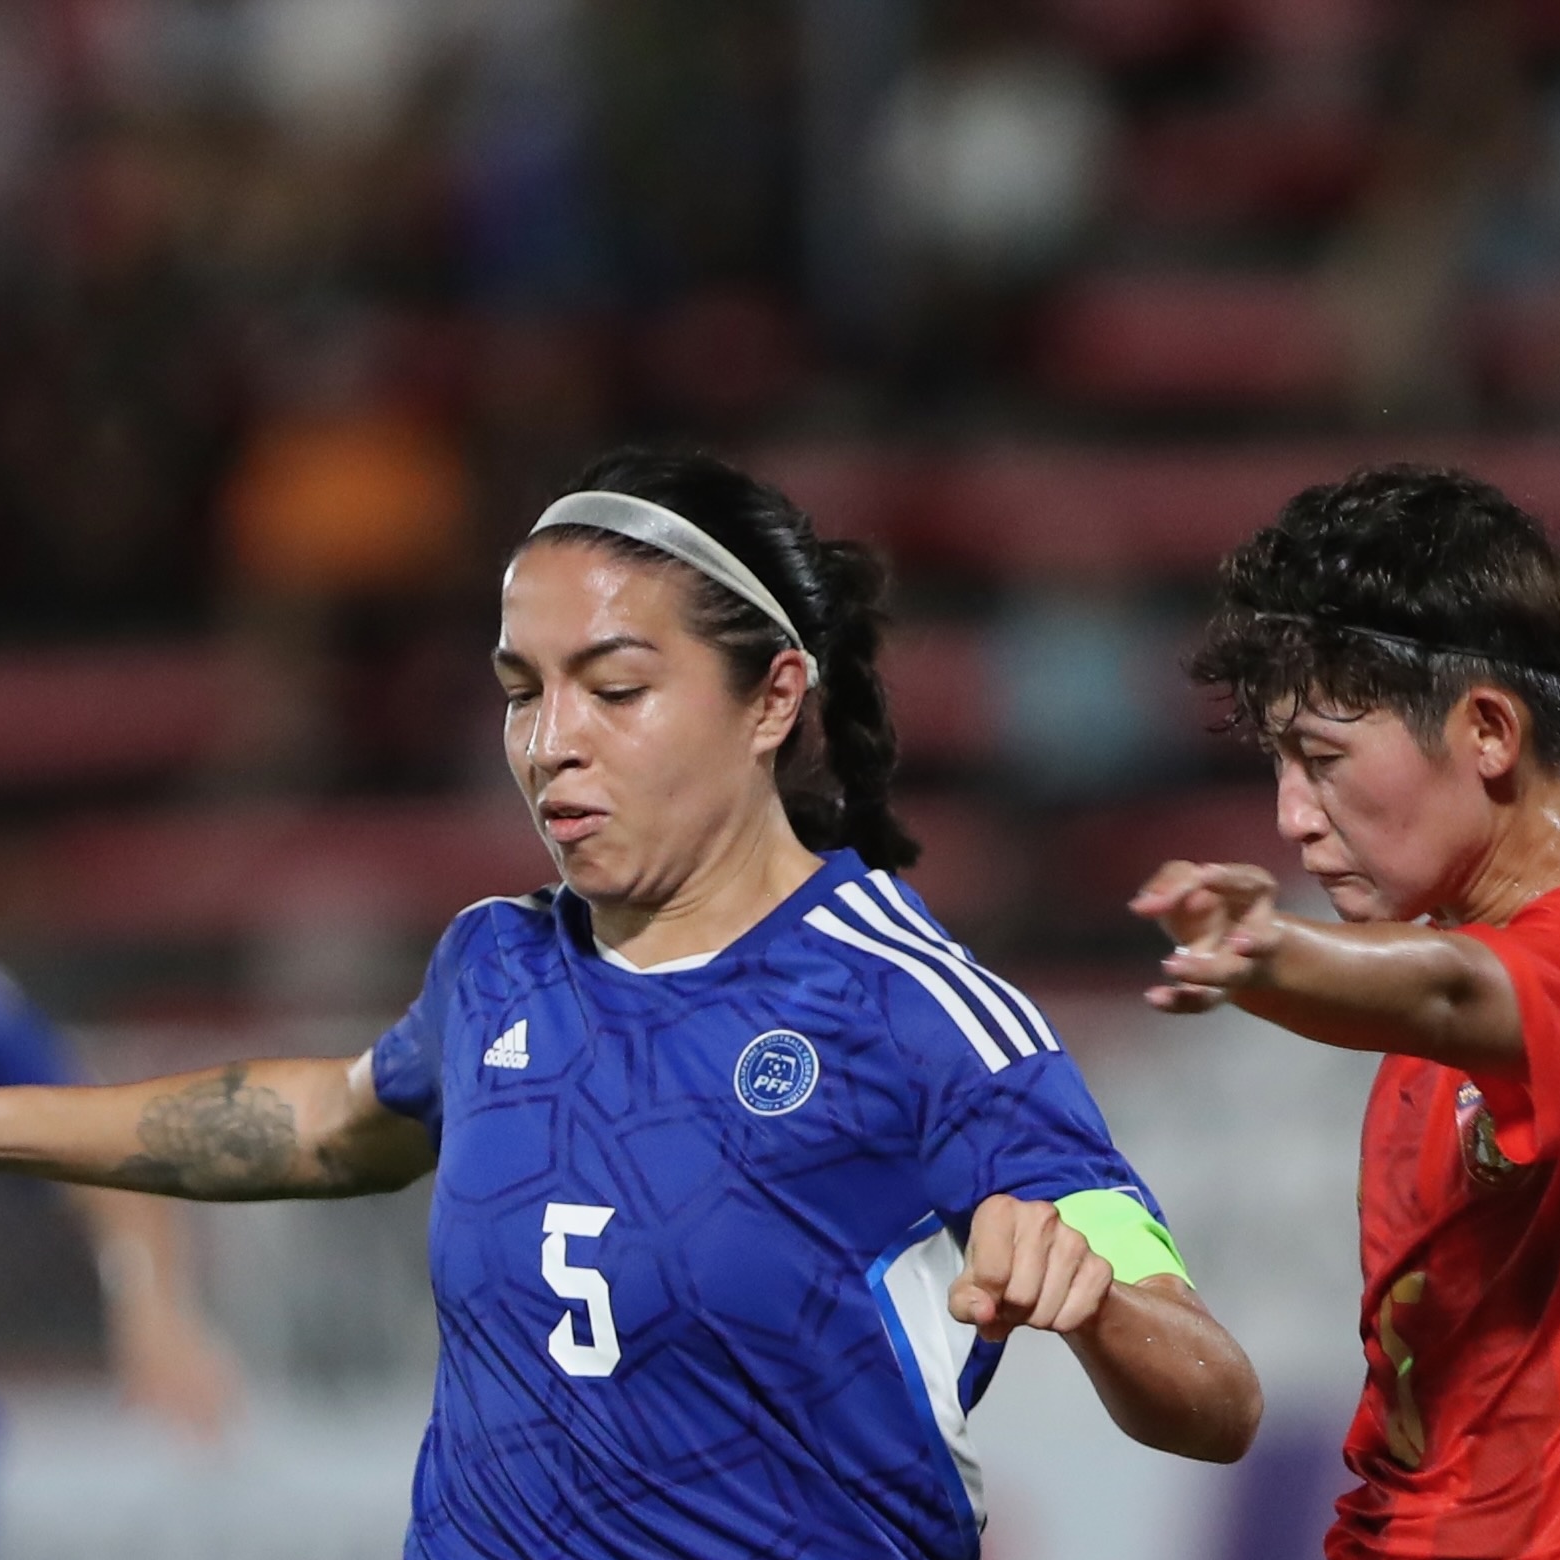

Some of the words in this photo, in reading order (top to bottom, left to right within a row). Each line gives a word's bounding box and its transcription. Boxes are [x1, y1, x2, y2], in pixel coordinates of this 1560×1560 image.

[483, 1048, 530, 1069] adidas
[753, 1075, 793, 1094] PFF
[541, 1202, 622, 1377] 5
